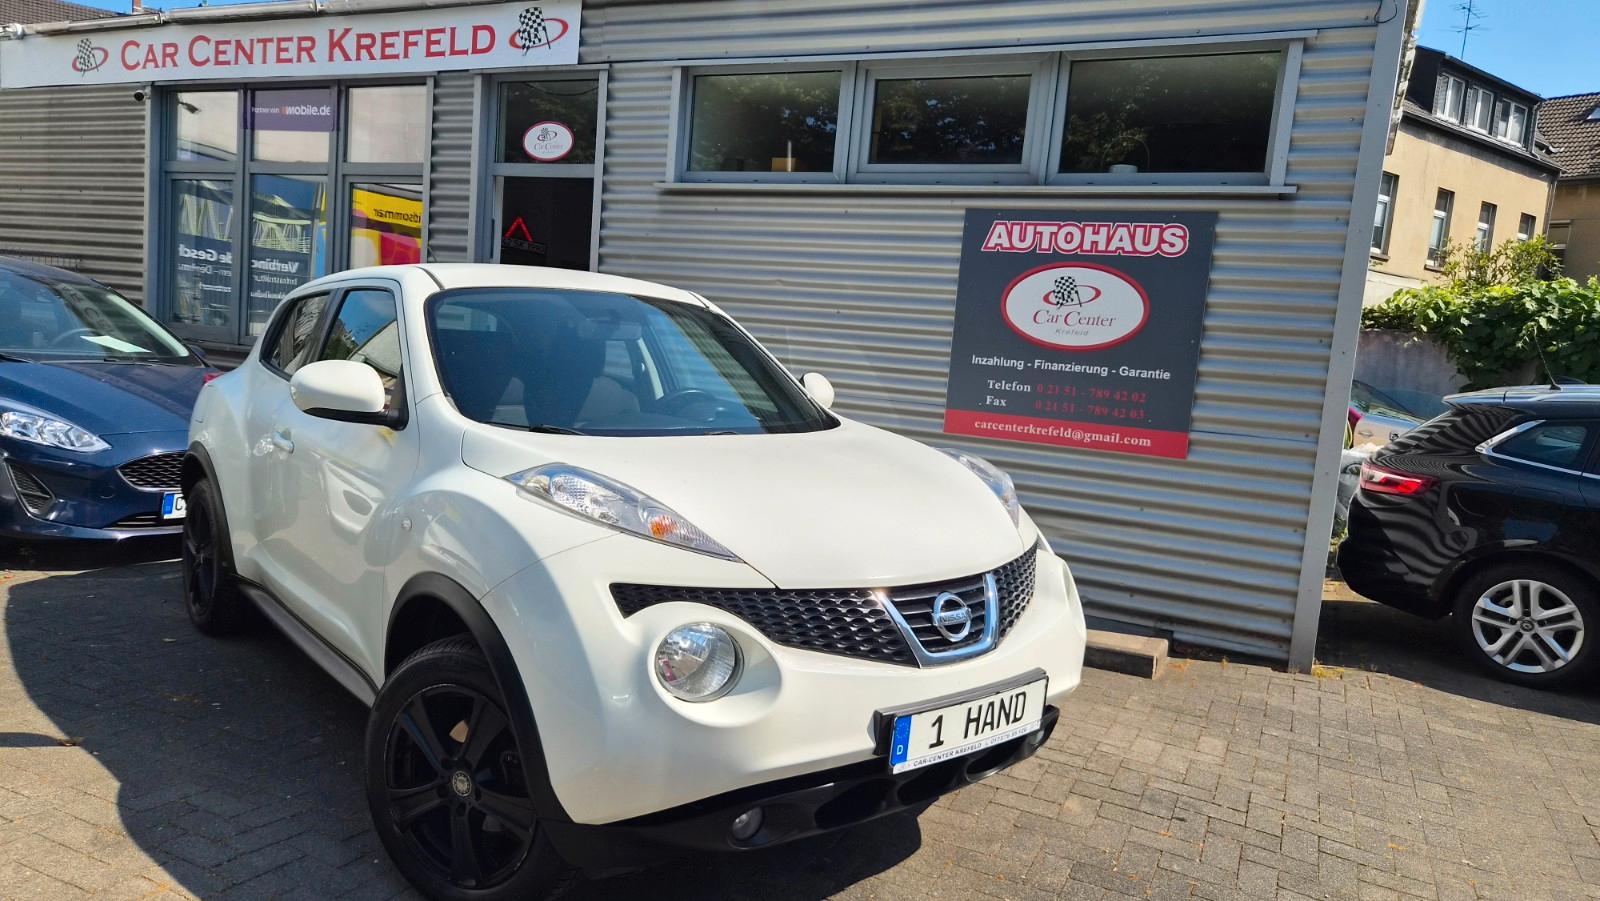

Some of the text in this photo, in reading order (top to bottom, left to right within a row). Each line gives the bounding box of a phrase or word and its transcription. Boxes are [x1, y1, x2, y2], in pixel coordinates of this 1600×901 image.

[120, 24, 497, 71] CAR CENTER KREFELD
[981, 220, 1189, 258] AUTOHAUS
[1033, 309, 1117, 327] Car Center
[971, 355, 1024, 370] Inzahlung
[1034, 359, 1109, 377] Finanzierung
[1119, 366, 1171, 380] Garantie
[987, 379, 1031, 393] Telefon
[986, 396, 1007, 407] Fax
[974, 419, 1152, 447] carcenterkrefeld@gmail.com
[896, 744, 903, 756] D
[928, 714, 945, 749] 1
[963, 691, 1027, 740] HAND
